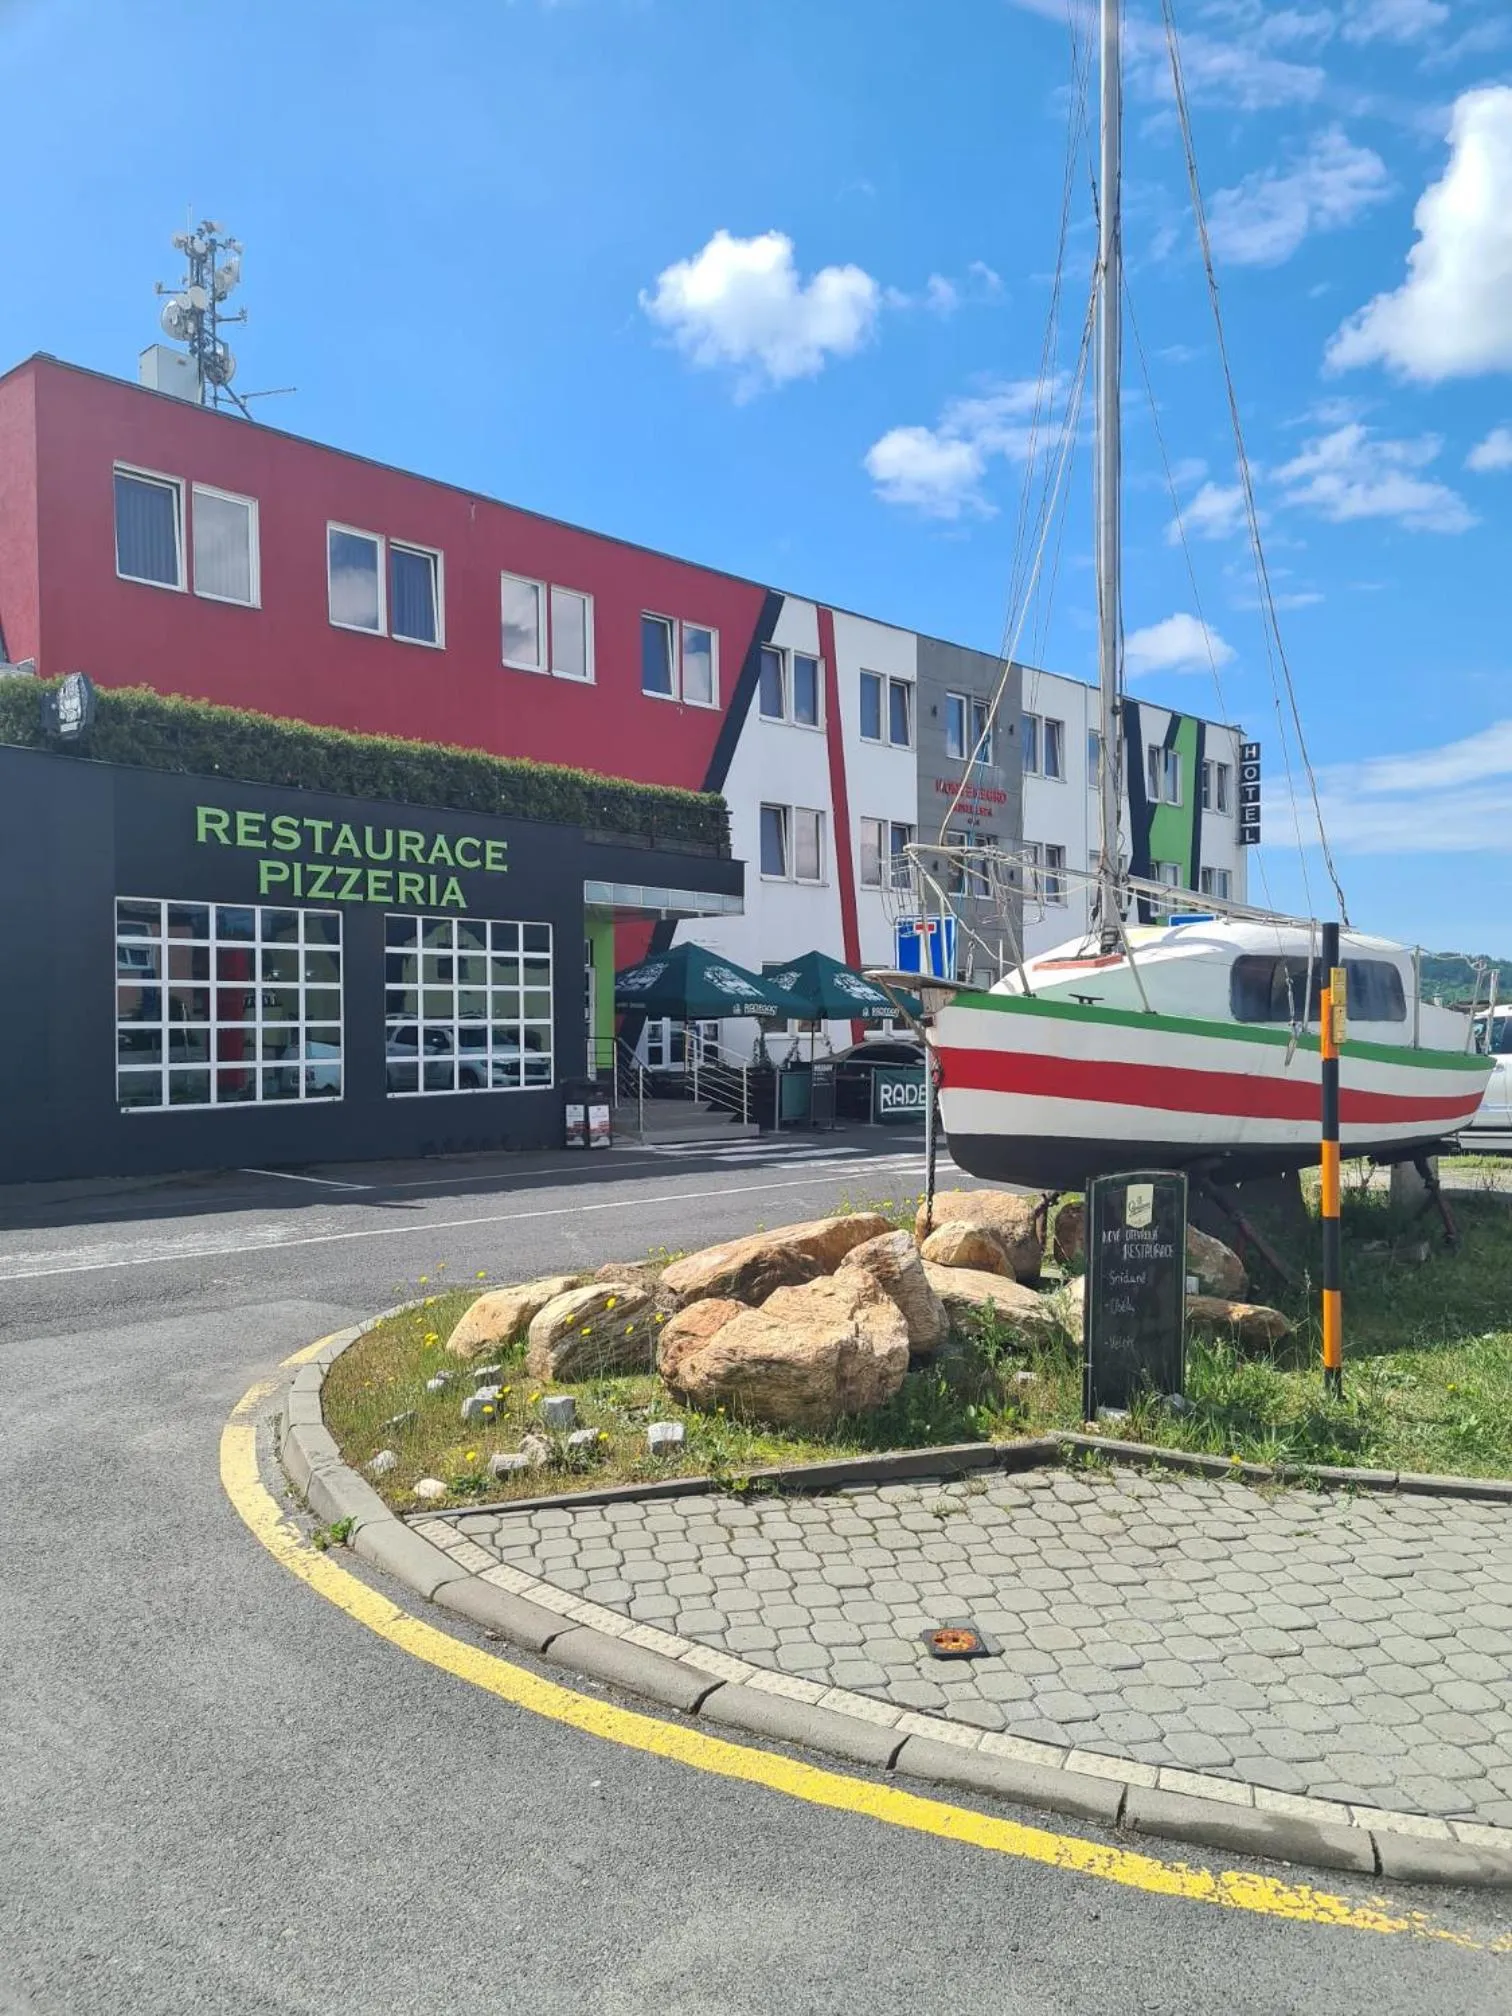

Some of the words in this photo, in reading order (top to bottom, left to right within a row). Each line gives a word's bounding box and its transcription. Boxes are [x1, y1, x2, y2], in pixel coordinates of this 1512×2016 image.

[1244, 745, 1258, 842] HOTEL
[196, 806, 508, 872] RESTAURACE
[258, 859, 468, 908] PIZZERIA
[880, 1083, 926, 1112] RADE
